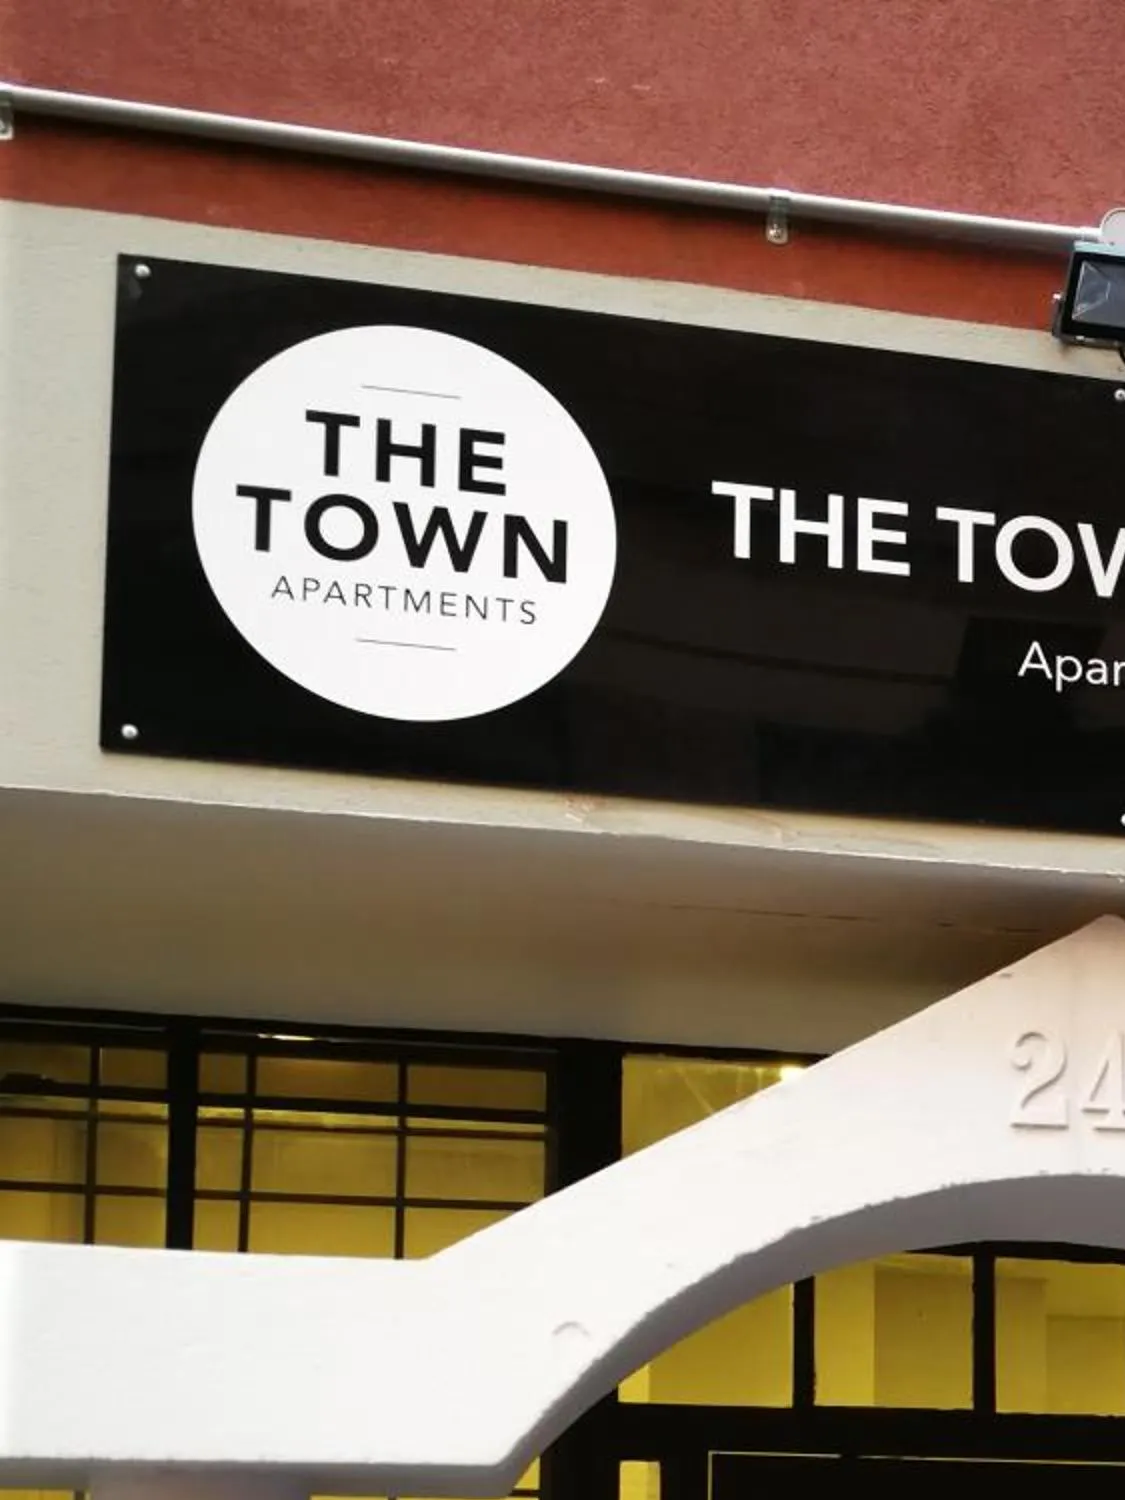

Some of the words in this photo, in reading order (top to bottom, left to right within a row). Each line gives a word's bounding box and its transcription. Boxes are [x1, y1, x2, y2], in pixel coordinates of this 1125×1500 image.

[306, 410, 506, 496] THE
[236, 484, 568, 584] TOWN
[711, 480, 911, 577] THE
[271, 574, 538, 626] APARTMENTS
